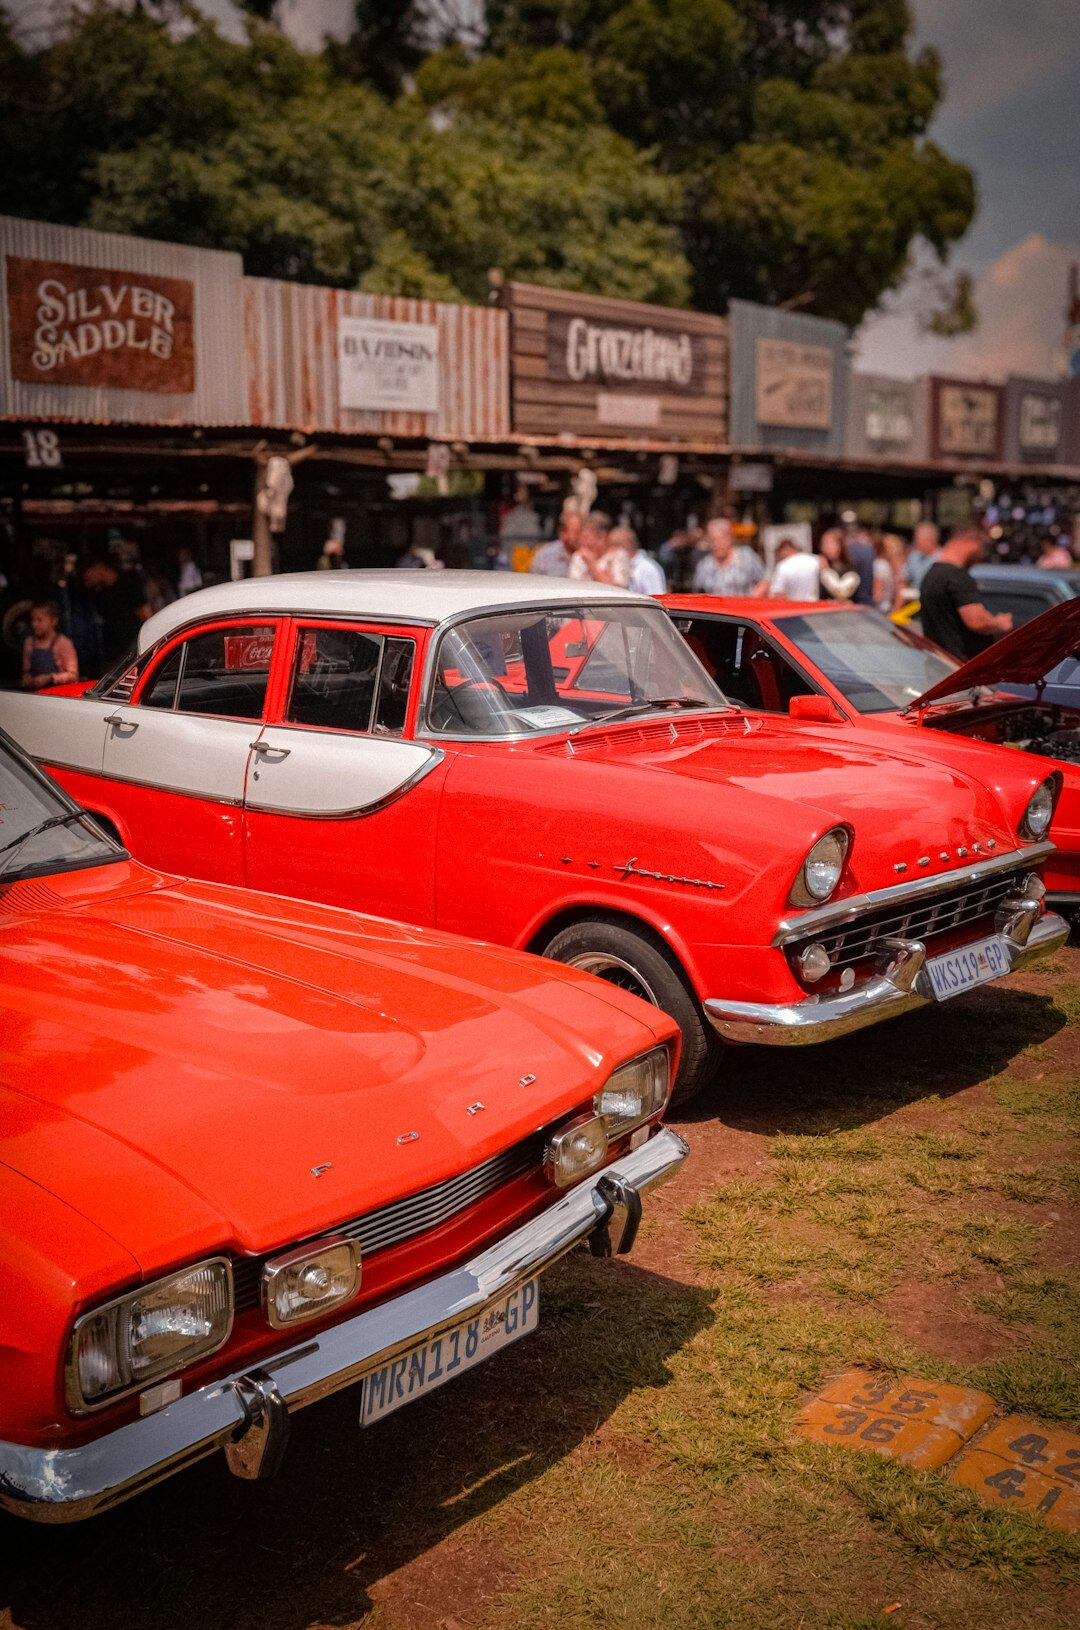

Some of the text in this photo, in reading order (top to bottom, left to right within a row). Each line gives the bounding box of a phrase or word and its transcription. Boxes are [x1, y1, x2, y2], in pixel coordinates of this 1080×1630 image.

[37, 279, 175, 332] SILVER
[32, 320, 173, 371] SADDLE
[22, 429, 61, 468] 18
[930, 943, 1002, 992] WKS119 GP
[310, 1073, 537, 1178] FORD
[367, 1320, 480, 1416] MRN118
[504, 1280, 536, 1335] GP
[851, 1382, 938, 1415] 35
[823, 1410, 905, 1443] 36
[1008, 1433, 1080, 1487] 42
[984, 1468, 1063, 1514] 41
